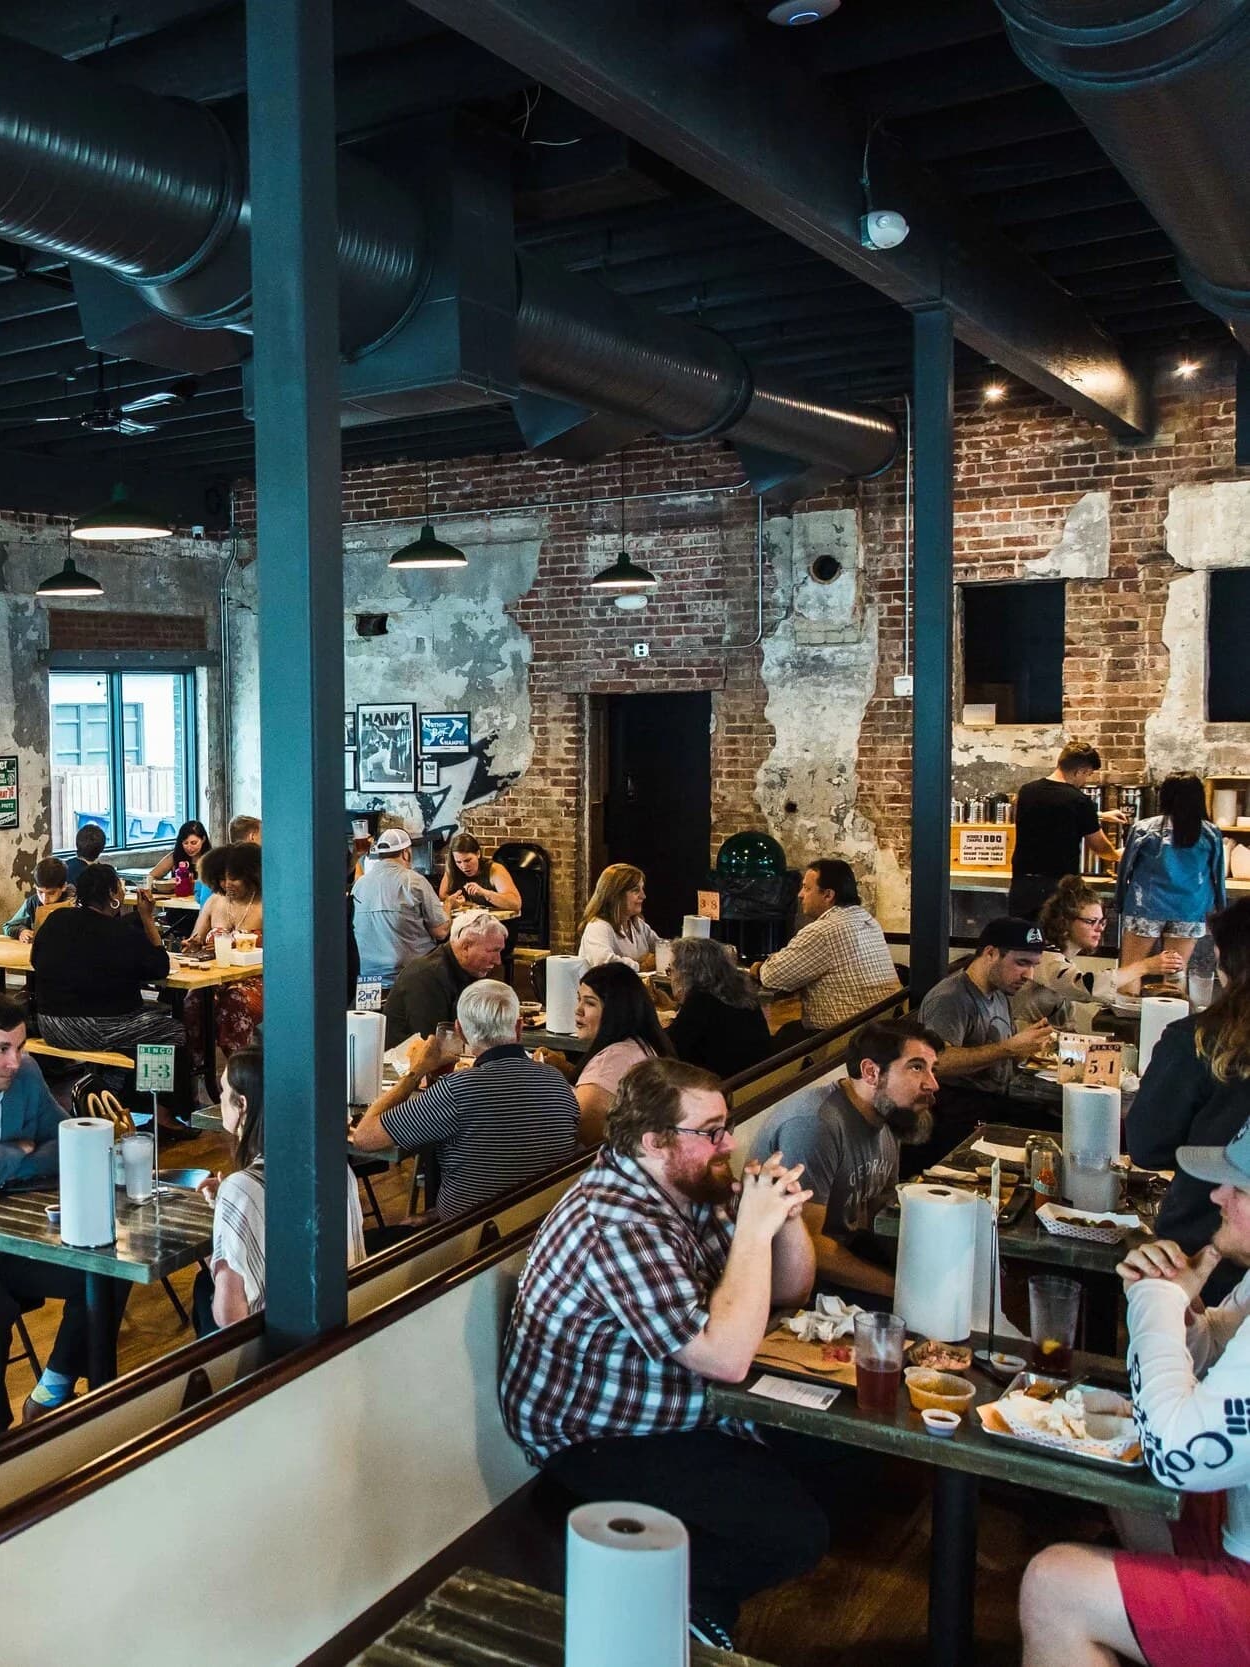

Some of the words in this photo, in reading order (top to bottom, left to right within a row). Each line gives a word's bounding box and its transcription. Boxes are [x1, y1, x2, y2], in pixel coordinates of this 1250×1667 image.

[358, 975, 382, 983] BINGO
[140, 1046, 172, 1055] BINGO
[1090, 1043, 1120, 1052] BINGO
